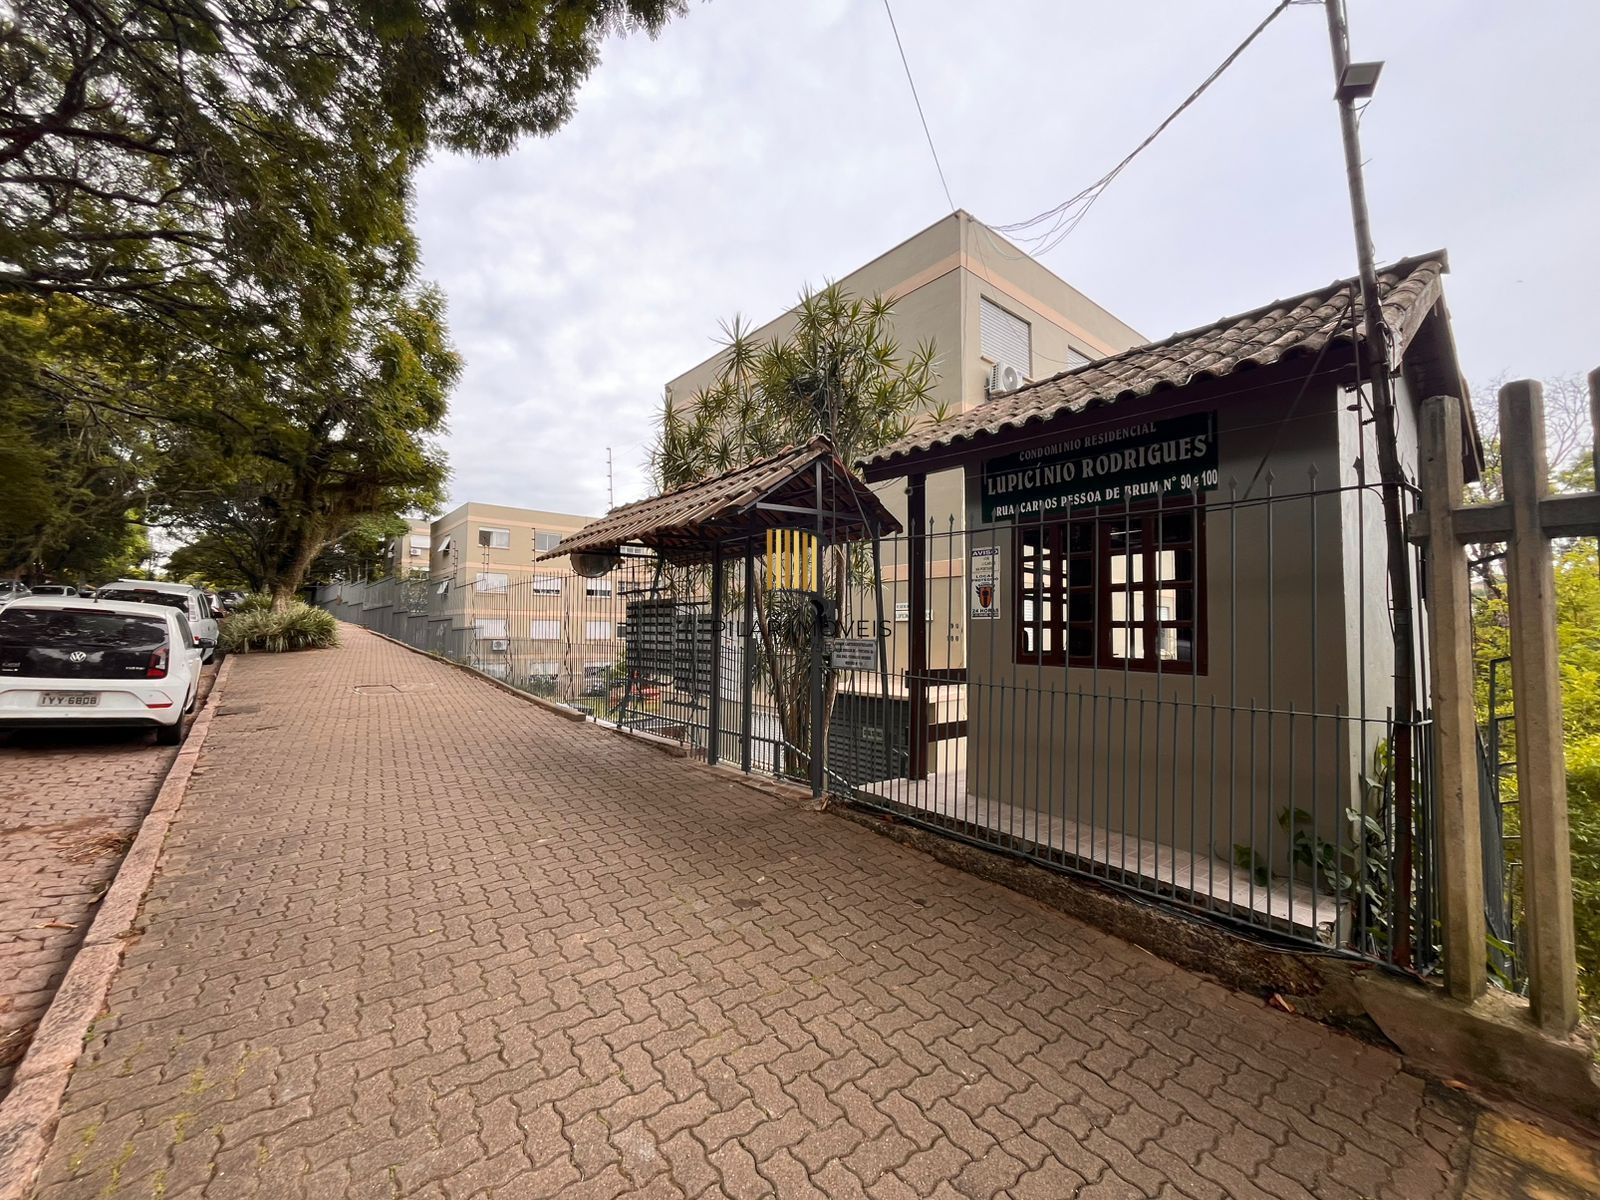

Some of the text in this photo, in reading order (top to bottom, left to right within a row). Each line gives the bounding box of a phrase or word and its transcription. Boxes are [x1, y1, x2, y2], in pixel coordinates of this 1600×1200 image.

[988, 434, 1207, 495] LUPICÍNIO RODRIGUES
[1020, 422, 1157, 461] CONDOMINIO RESIDENCIAL
[996, 504, 1015, 517] RUA
[1060, 490, 1101, 507] PESSOA
[1105, 487, 1120, 500] DE
[1124, 481, 1159, 496] BRUM
[1180, 473, 1191, 489] 90
[1201, 468, 1218, 486] 100
